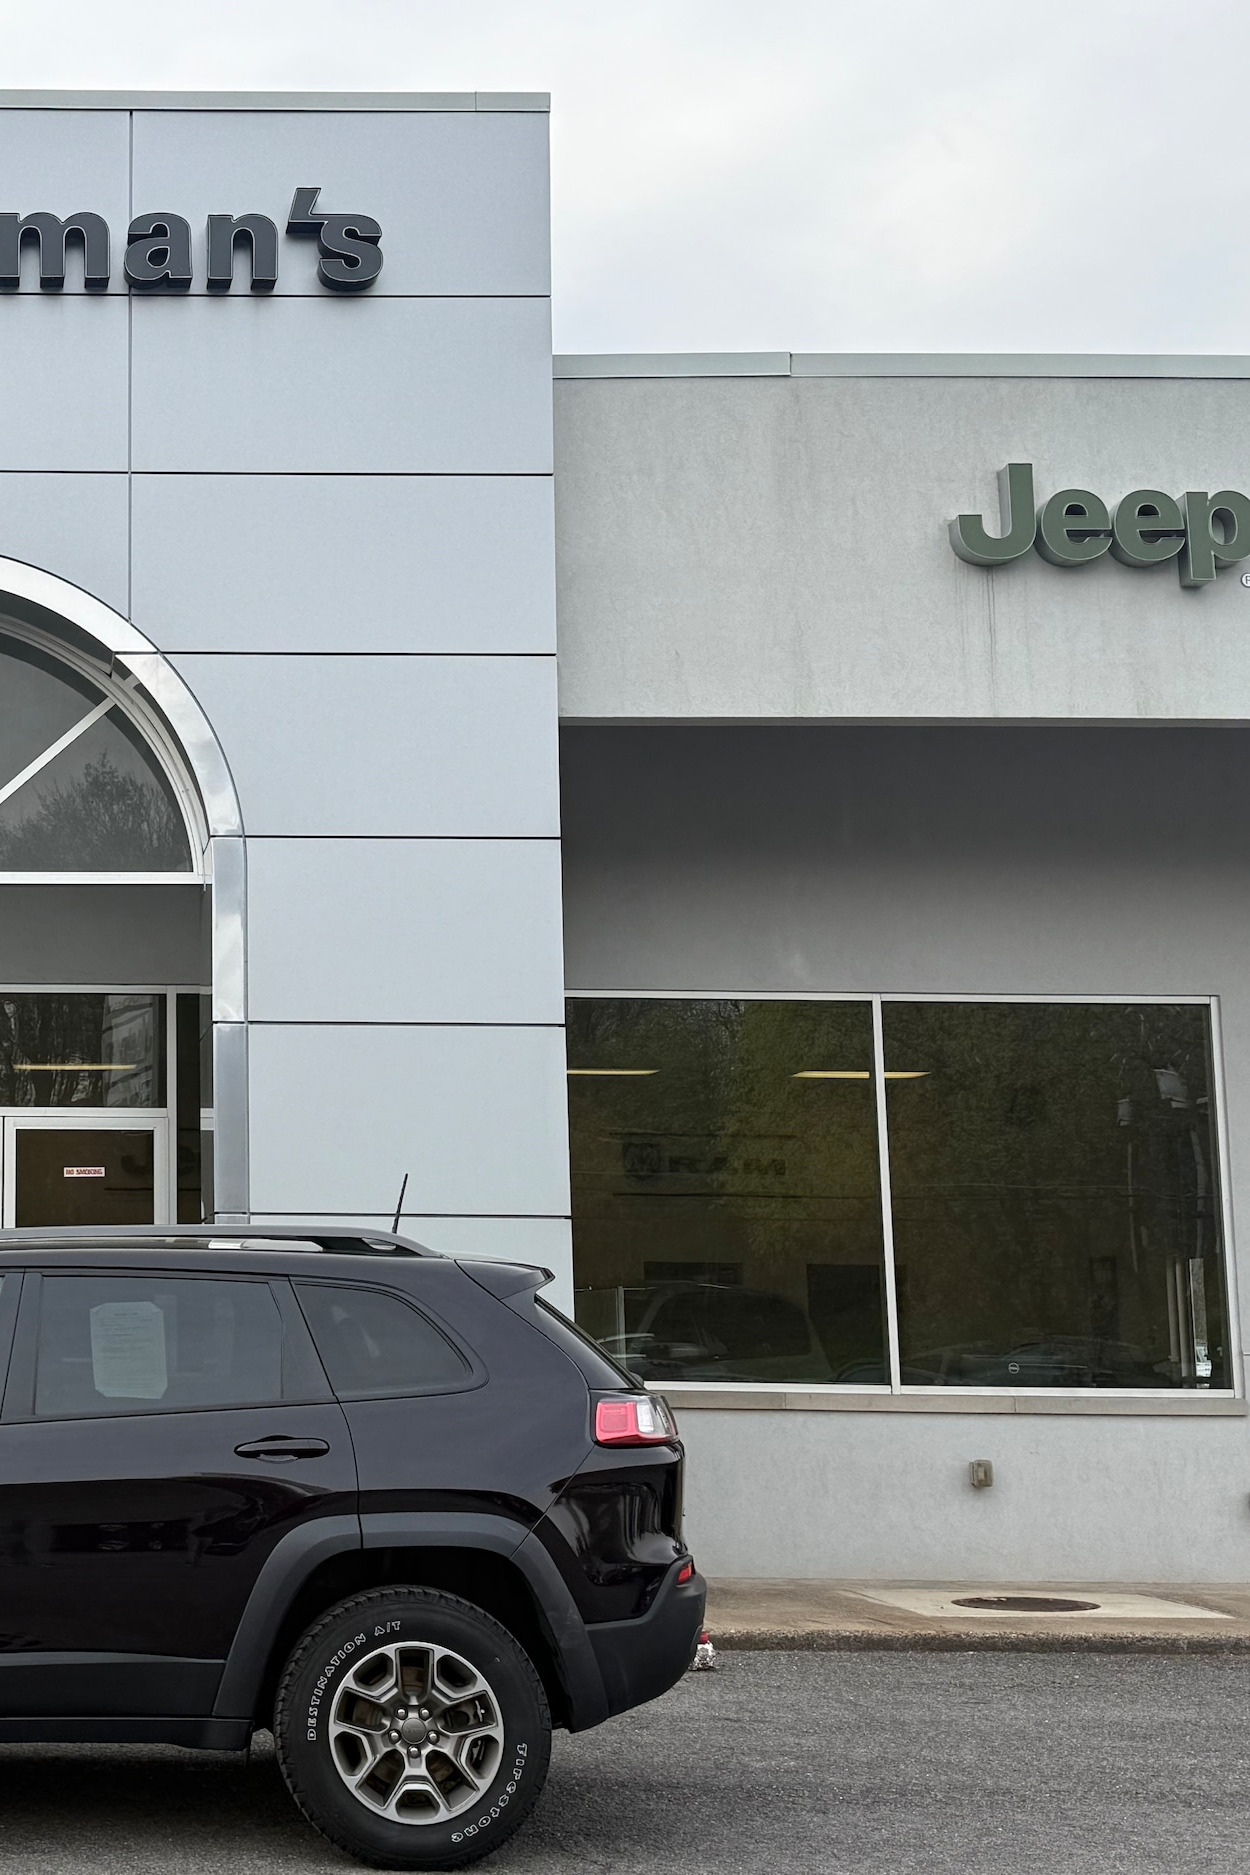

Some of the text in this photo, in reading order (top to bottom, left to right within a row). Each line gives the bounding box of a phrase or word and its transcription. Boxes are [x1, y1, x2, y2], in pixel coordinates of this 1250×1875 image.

[948, 462, 1250, 588] Jeep
[307, 1620, 401, 1741] DESTINATION A/T
[451, 1743, 528, 1842] Firestone
